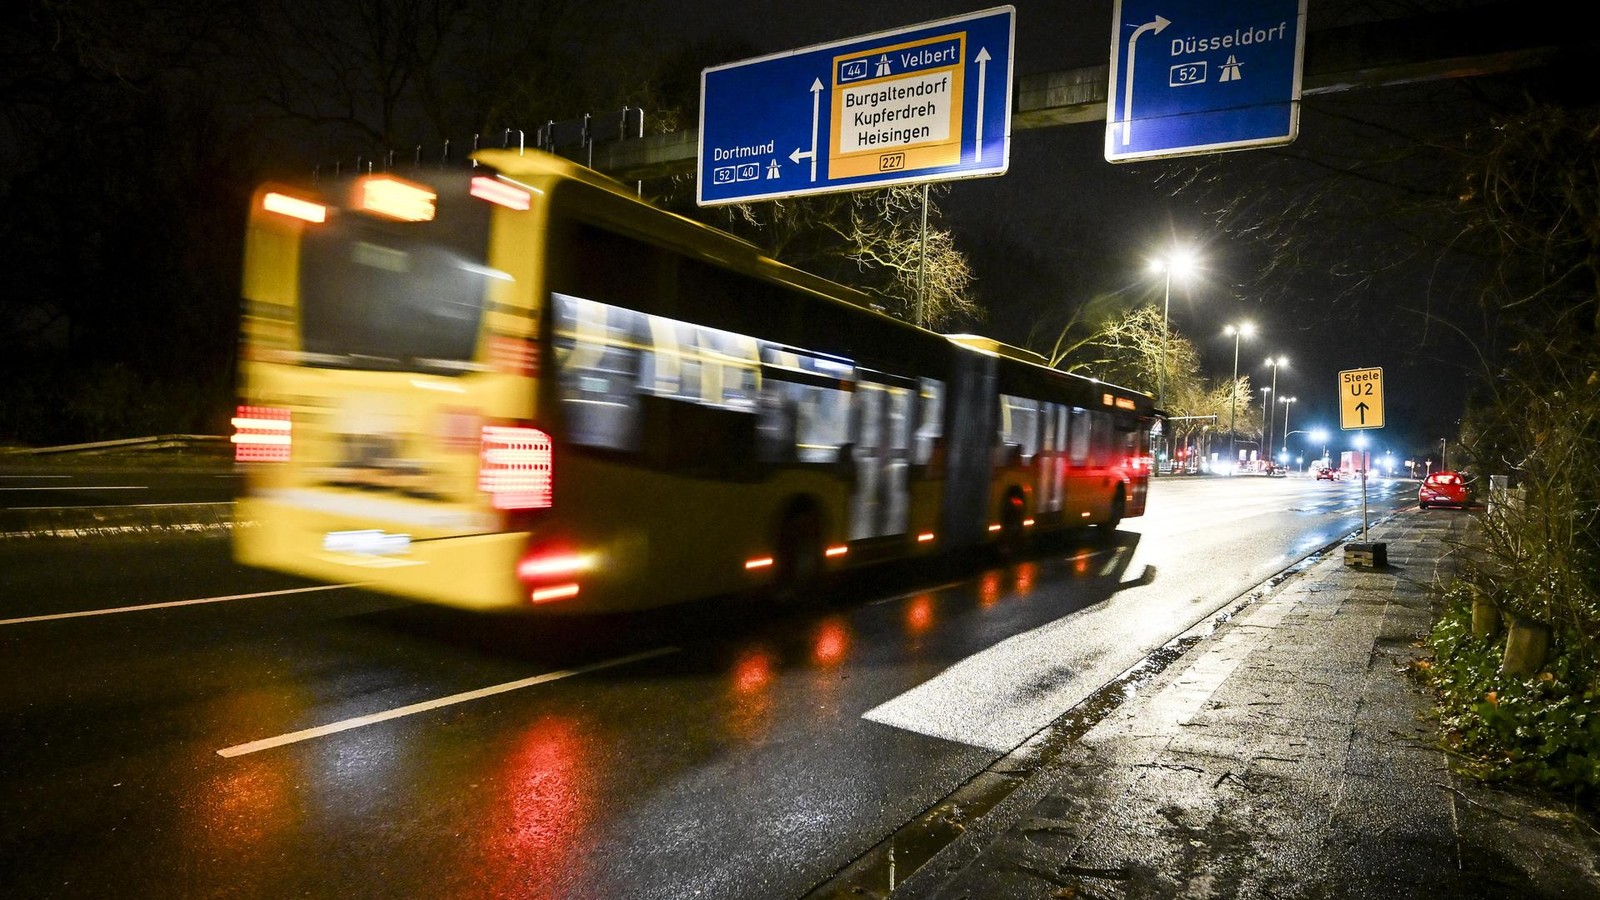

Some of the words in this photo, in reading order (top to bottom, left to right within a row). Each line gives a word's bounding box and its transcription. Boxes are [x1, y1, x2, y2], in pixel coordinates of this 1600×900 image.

[1171, 22, 1286, 56] Düsseldorf
[847, 65, 861, 76] 44
[901, 46, 956, 68] Velbert
[1179, 67, 1197, 82] 52
[846, 78, 948, 108] Burgaltendorf
[854, 102, 936, 128] Kupferdreh
[858, 126, 929, 146] Heisingen
[714, 140, 774, 161] Dortmund
[882, 156, 902, 168] 227
[719, 169, 730, 180] 52
[742, 167, 754, 177] 40
[1344, 371, 1379, 383] Steele
[1351, 382, 1373, 396] U2
